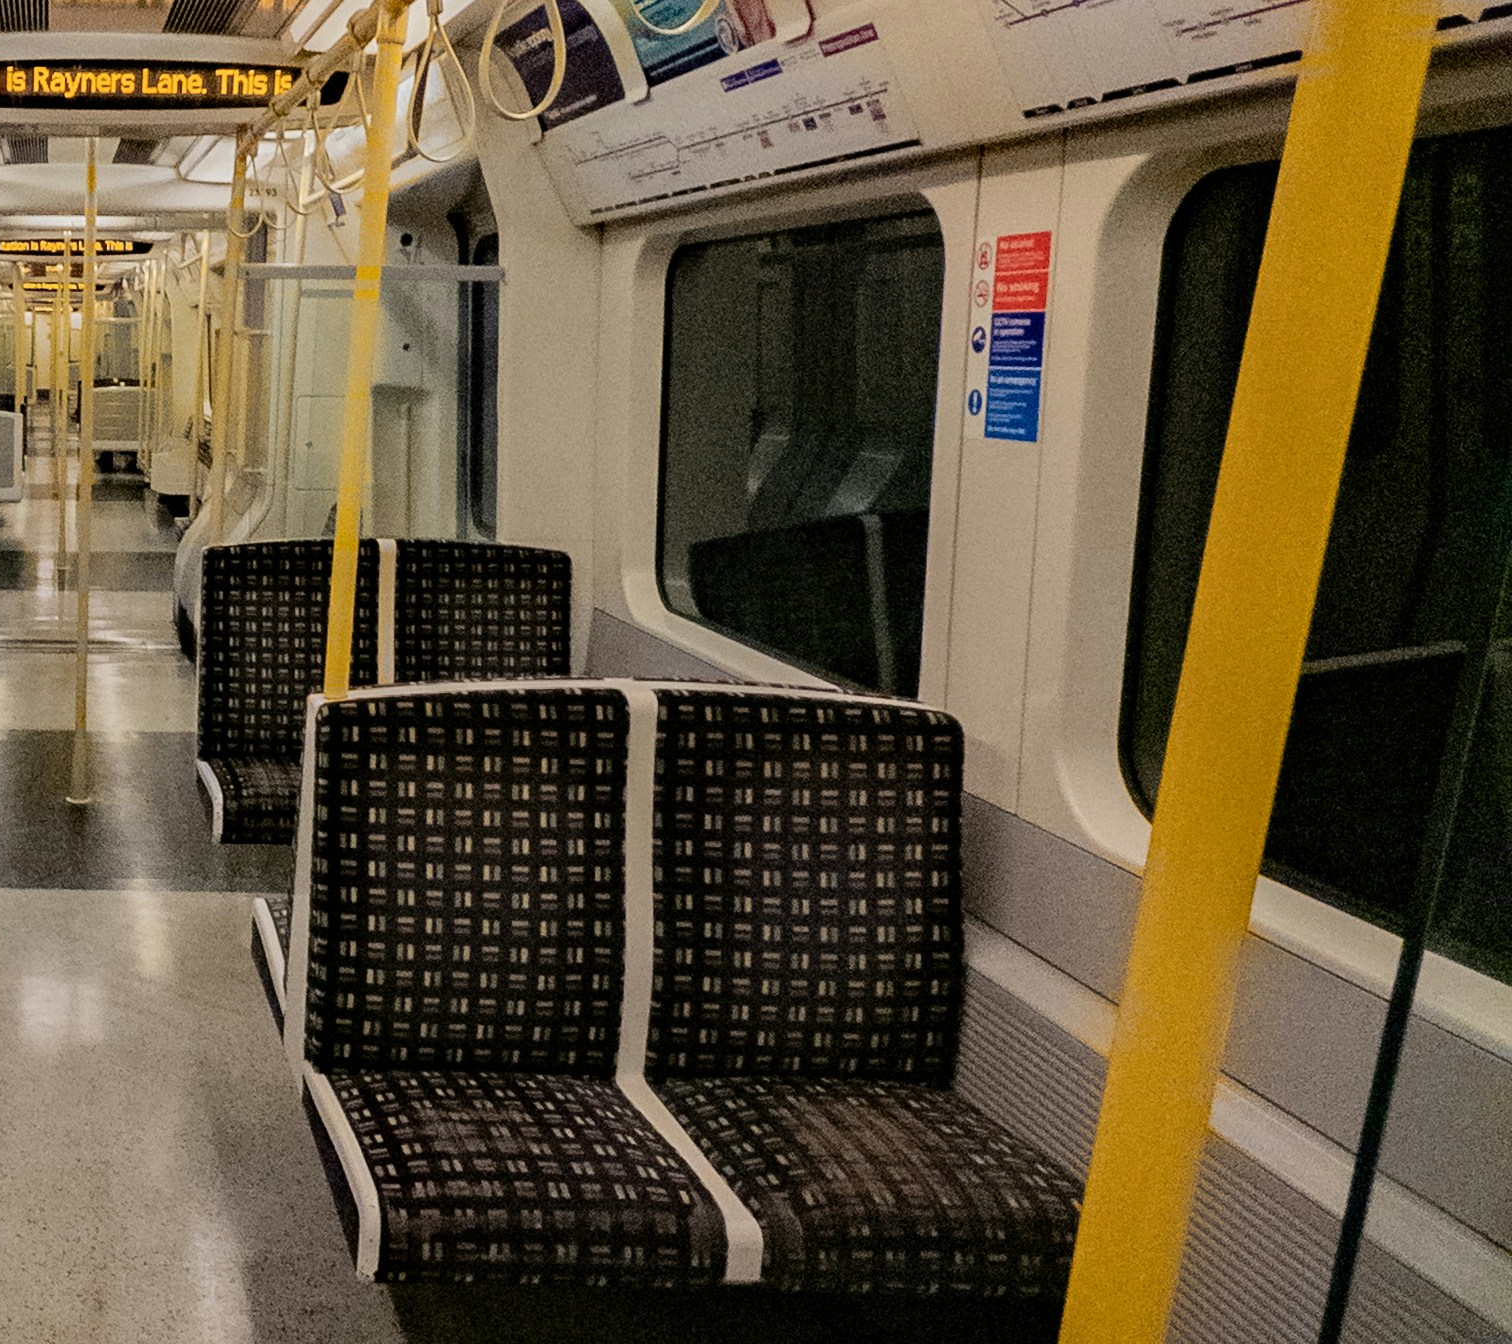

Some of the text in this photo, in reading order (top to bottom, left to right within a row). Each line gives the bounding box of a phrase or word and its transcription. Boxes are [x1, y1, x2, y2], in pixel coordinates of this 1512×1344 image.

[6, 66, 26, 92] is
[33, 67, 133, 98] Rayners
[142, 68, 207, 95] Lane.
[216, 69, 268, 95] This
[274, 70, 292, 96] is
